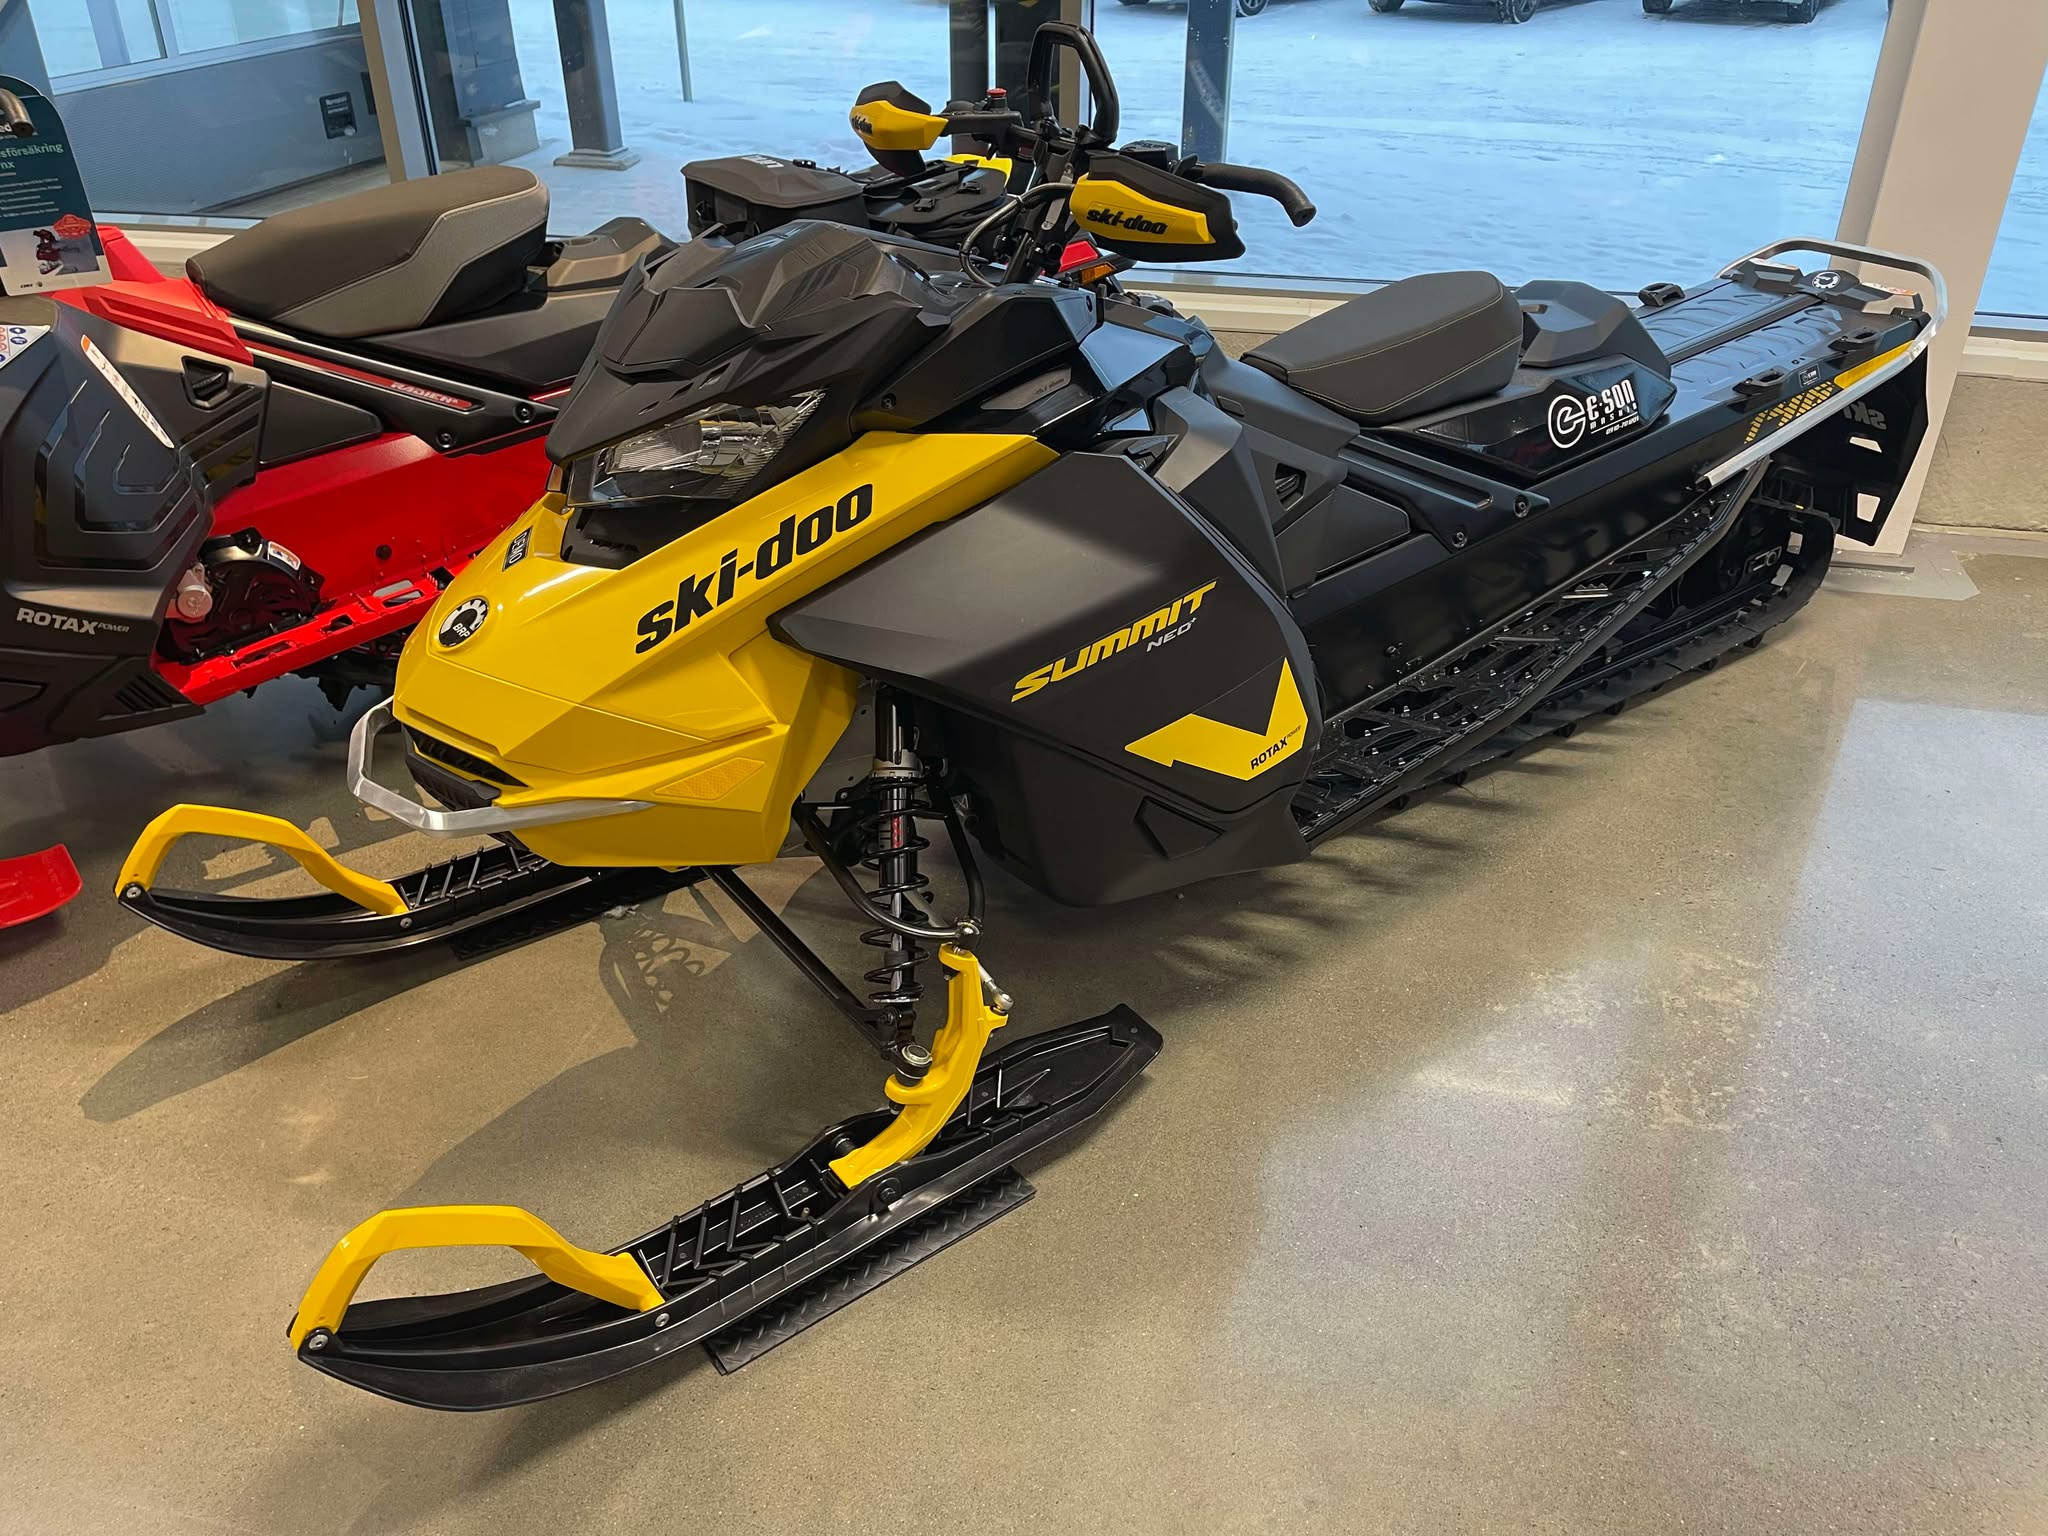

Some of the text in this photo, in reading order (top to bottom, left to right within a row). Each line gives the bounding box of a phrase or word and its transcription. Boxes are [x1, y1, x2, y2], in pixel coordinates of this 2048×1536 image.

[1086, 208, 1168, 235] ski-doo
[508, 531, 528, 564] DEMO
[635, 484, 873, 655] ski-doo
[17, 607, 130, 635] ROTAX POWER
[452, 622, 471, 638] BRP
[1011, 581, 1217, 703] SUMMIT
[1250, 735, 1287, 770] ROTAX
